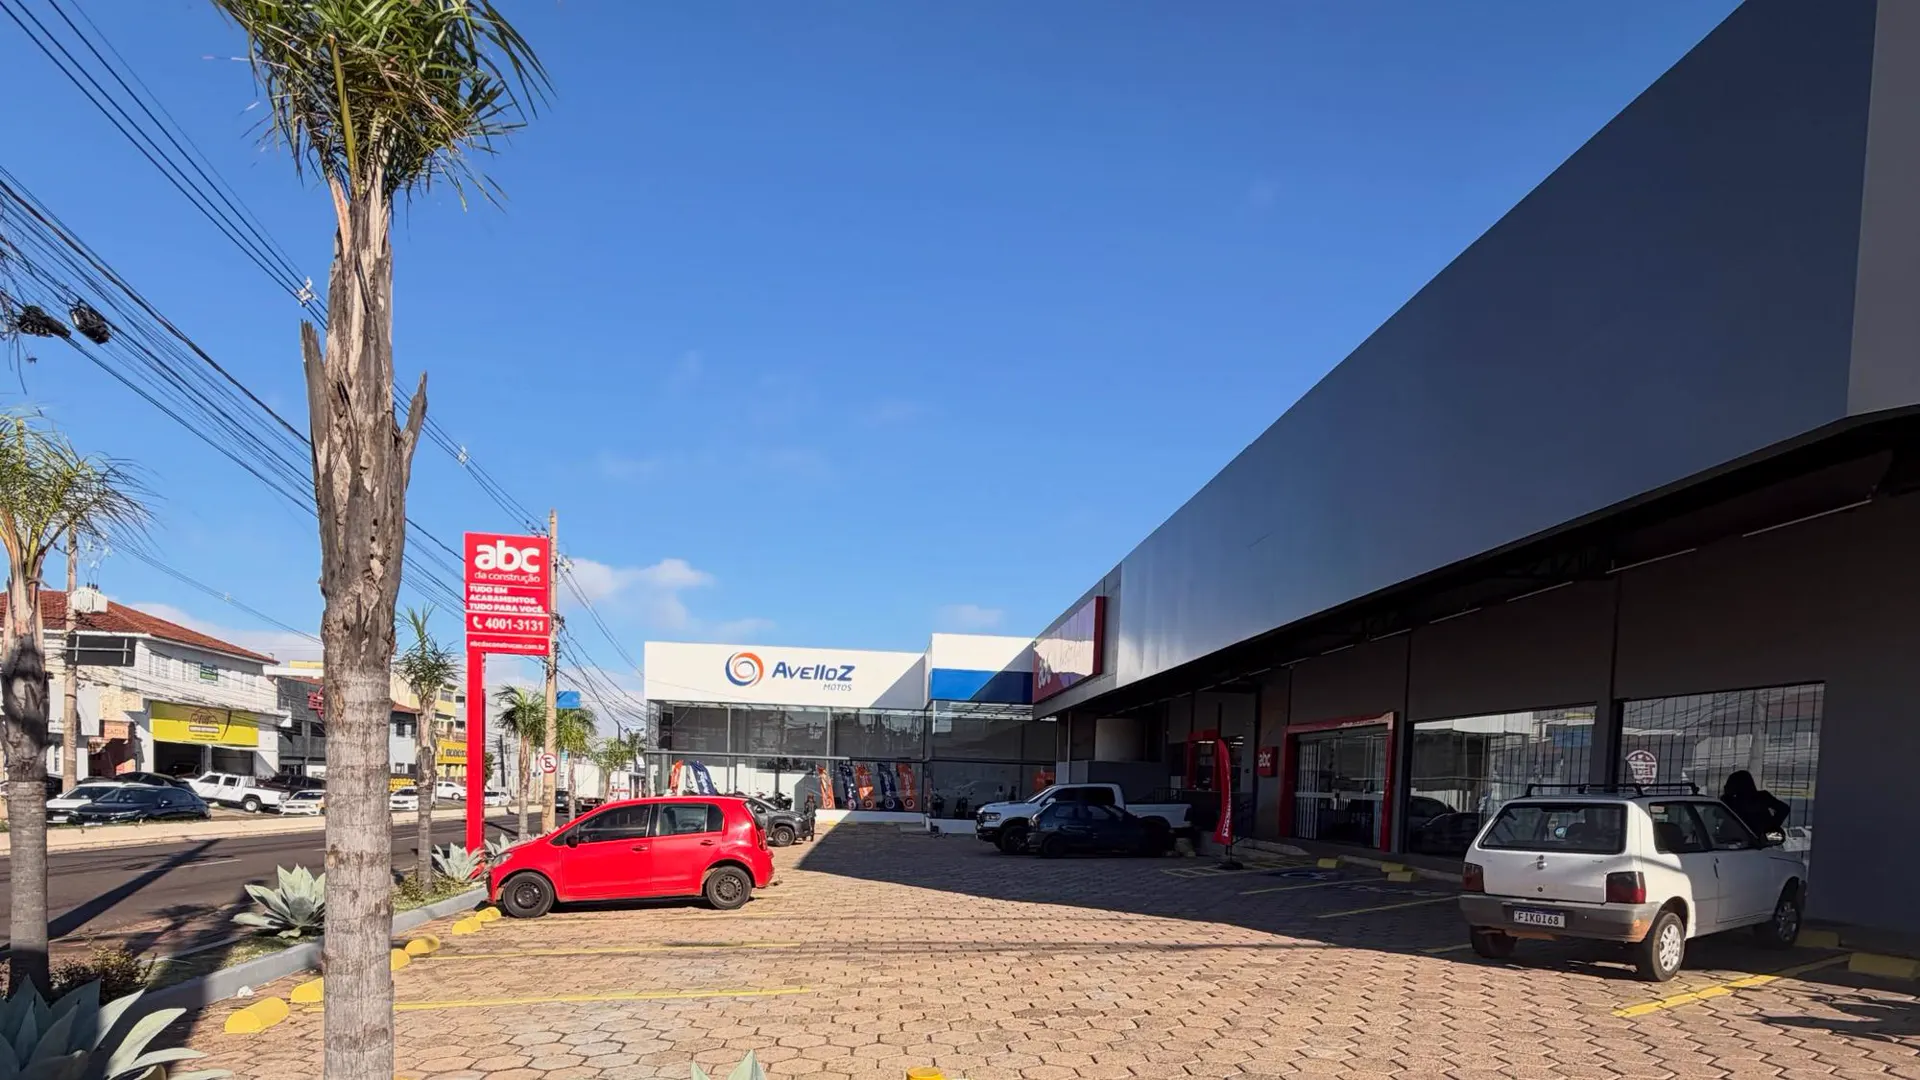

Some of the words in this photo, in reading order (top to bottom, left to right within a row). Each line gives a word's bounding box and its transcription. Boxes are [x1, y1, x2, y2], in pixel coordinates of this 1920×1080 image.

[474, 540, 540, 573] abc
[474, 571, 488, 581] da
[488, 573, 540, 584] construção
[469, 586, 492, 594] TUDO
[485, 618, 544, 631] 4001-3131
[823, 683, 852, 692] MOTOS
